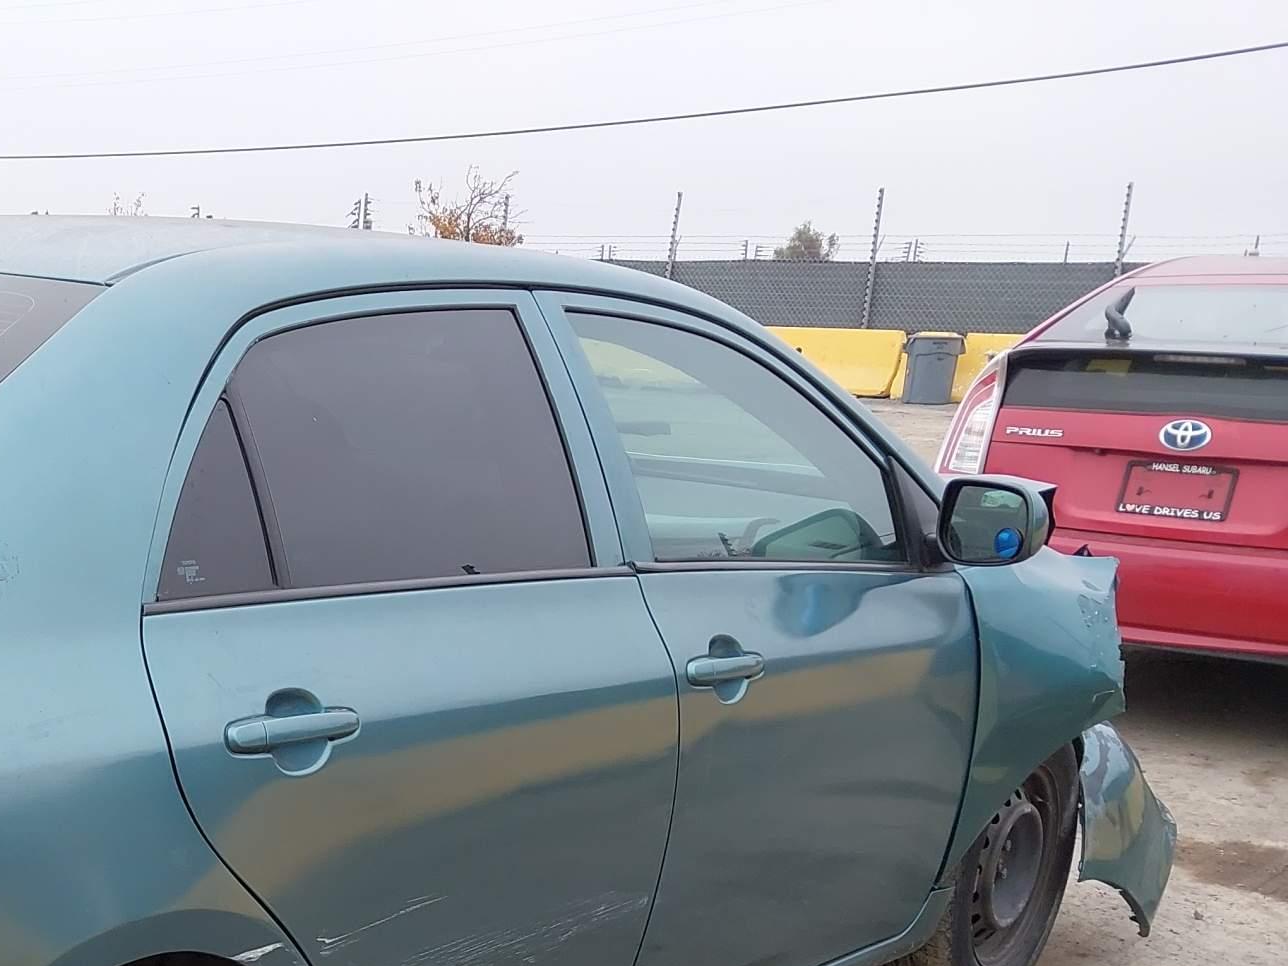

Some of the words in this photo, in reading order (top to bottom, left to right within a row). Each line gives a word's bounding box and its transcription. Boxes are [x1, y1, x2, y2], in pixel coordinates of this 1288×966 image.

[1006, 426, 1064, 437] PRIUS
[1152, 462, 1180, 472] HANSEL
[1182, 465, 1213, 475] SUBARU
[1153, 506, 1200, 518] DRIVES
[1203, 511, 1222, 520] US
